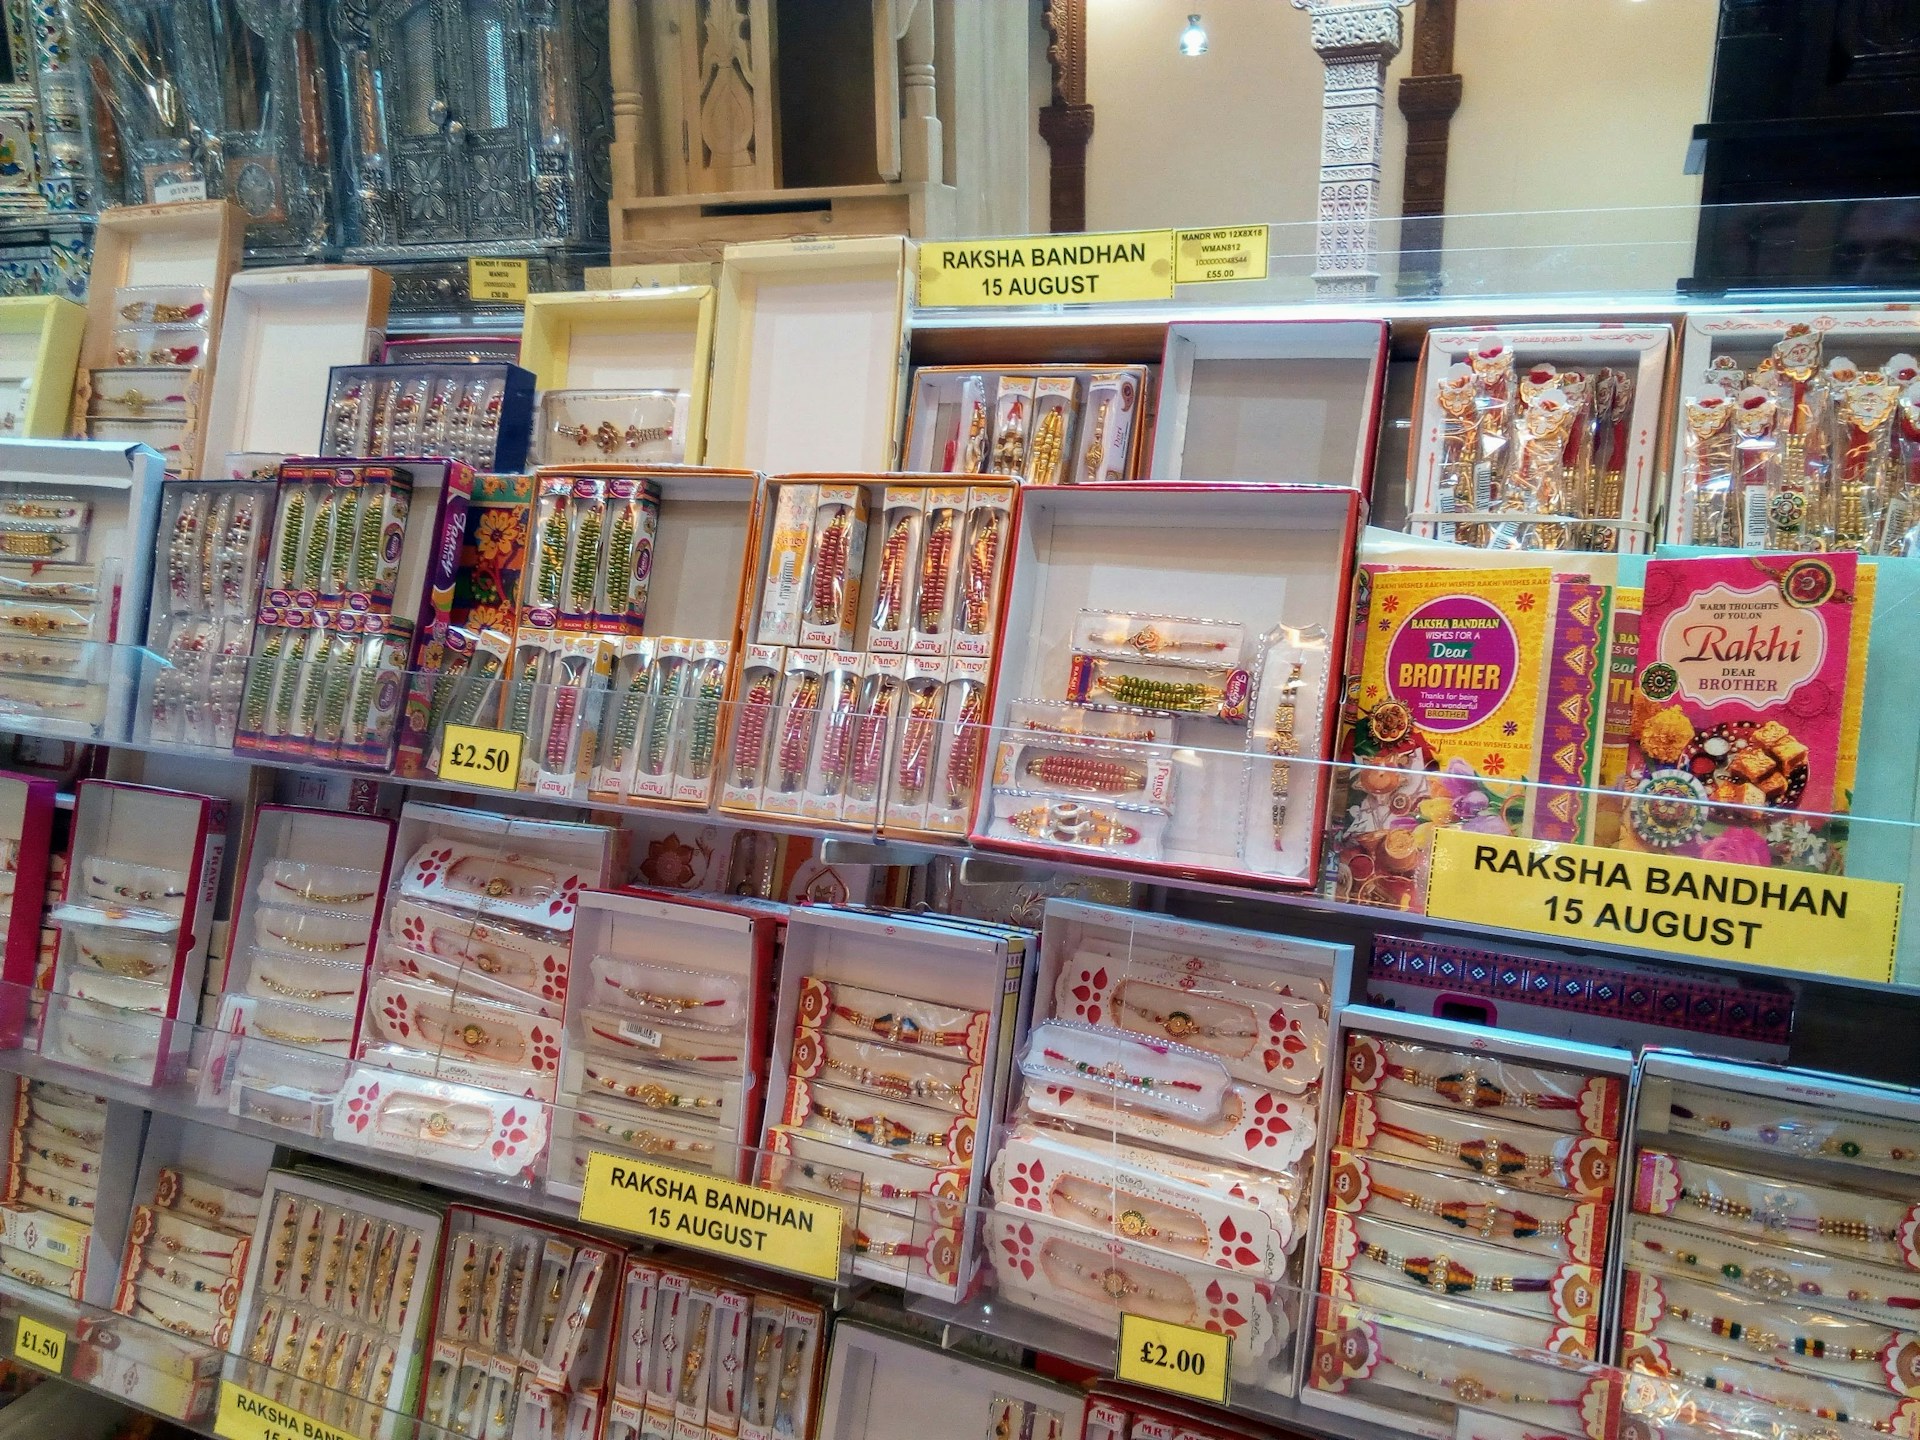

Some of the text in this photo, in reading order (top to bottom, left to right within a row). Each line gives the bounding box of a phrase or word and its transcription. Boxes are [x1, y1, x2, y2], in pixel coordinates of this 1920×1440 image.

[1213, 231, 1227, 239] WD
[942, 243, 1146, 270] RAKSHA BANDHAN
[1206, 270, 1234, 278] £55.00
[982, 274, 1100, 296] 15 AUGUST
[441, 512, 467, 578] Fancy
[1729, 602, 1779, 611] THOUGHTS
[1411, 618, 1500, 629] RAKSHA BANDHAN
[806, 632, 832, 645] Fancy
[1425, 631, 1481, 640] WISHES FOR A
[873, 638, 899, 651] Fancy
[915, 641, 942, 654] Fancy
[1432, 642, 1469, 659] Dear
[1679, 624, 1804, 663] Rakhi
[1069, 665, 1080, 692] RAKHI
[1398, 663, 1501, 690] BROTHER
[1722, 668, 1756, 677] DEAR
[1699, 678, 1778, 692] BROTHER
[1420, 691, 1479, 702] Thanks for being
[1418, 701, 1434, 709] such
[1441, 701, 1478, 710] wonderful
[1427, 709, 1467, 719] BROTHER
[450, 743, 509, 773] £2.50
[541, 783, 567, 796] Fancy
[639, 782, 663, 795] Fancy
[1152, 766, 1170, 800] Fancy
[1474, 844, 1849, 919] RAKSHA BANDHAN
[1543, 895, 1763, 949] 15 AUGUST
[610, 1167, 814, 1233] RAKSHA BANDHAN
[648, 1206, 768, 1251] 15 AUGUST
[790, 1312, 815, 1325] Fancy
[22, 1330, 58, 1360] £1.50
[438, 1345, 457, 1359] Fancy
[1140, 1341, 1206, 1376] £2.00
[494, 1362, 512, 1375] Fancy
[236, 1394, 299, 1433] RAKSHA
[615, 1405, 636, 1420] Fancy
